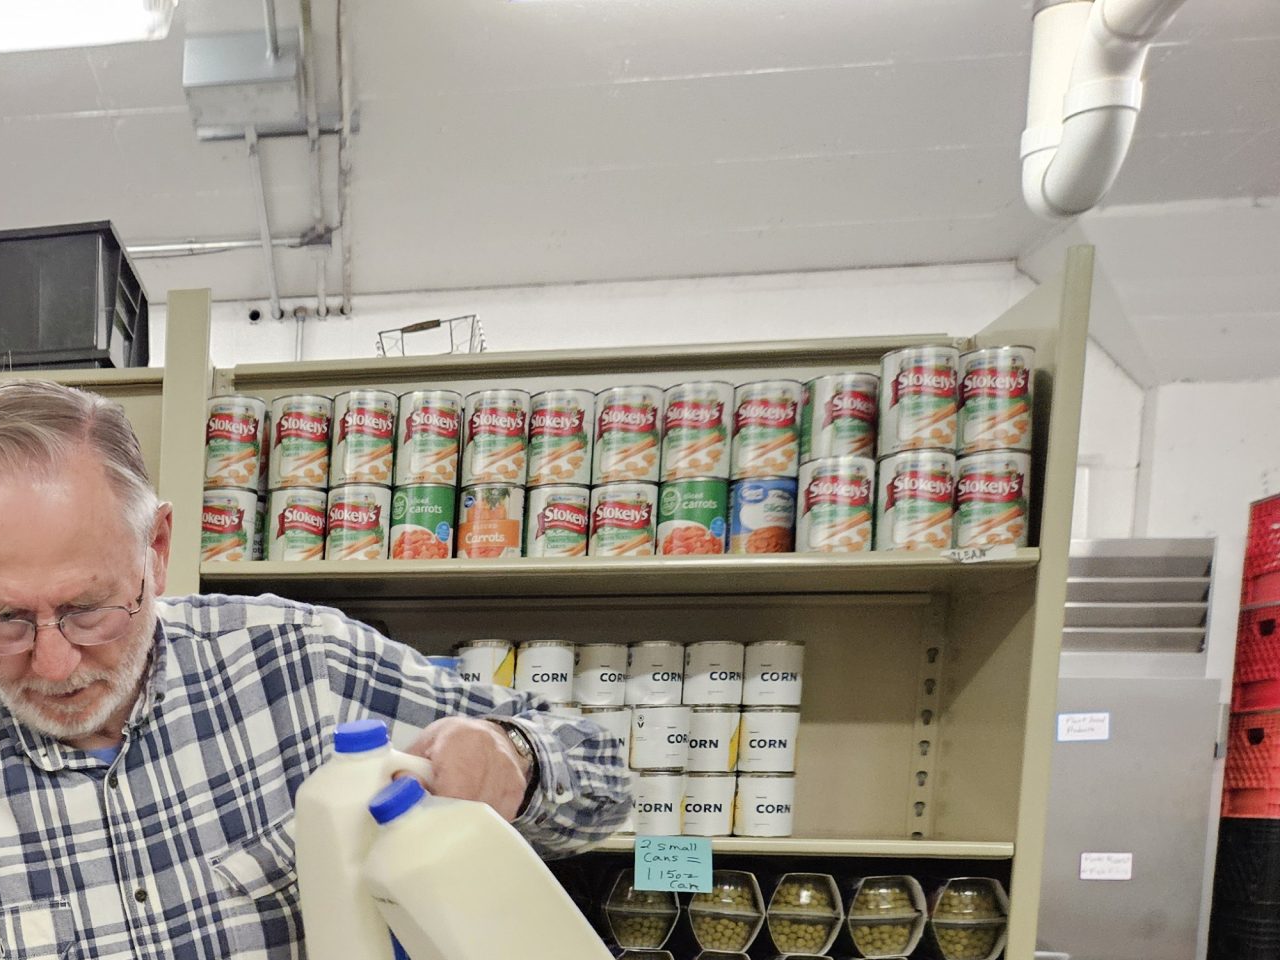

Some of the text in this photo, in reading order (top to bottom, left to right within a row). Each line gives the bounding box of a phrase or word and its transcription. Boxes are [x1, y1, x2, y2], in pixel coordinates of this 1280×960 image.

[898, 373, 956, 390] Stokely's
[963, 373, 1025, 390] Stokely's
[602, 408, 654, 424] Stokely's
[667, 405, 719, 422] Stokely's
[738, 402, 795, 420] Stokely's
[208, 416, 256, 434] Stokely's
[281, 416, 327, 432] Stokely's
[345, 411, 392, 430] Stokely's
[411, 411, 458, 430] Stokely's
[472, 412, 524, 430] Stokely's
[531, 412, 580, 429] Stokely's
[809, 482, 868, 498] Stokely's
[894, 477, 953, 493] Stokely's
[958, 477, 1018, 494] Stokely's
[409, 504, 442, 515] carrots
[682, 499, 718, 510] carrots
[329, 506, 379, 525] Stokely's
[596, 505, 649, 522] Stokely's
[465, 532, 505, 544] Carrots
[532, 673, 568, 683] CORN
[709, 671, 741, 682] CORN
[761, 671, 798, 682] CORN
[749, 738, 788, 749] CORN
[685, 803, 722, 813] CORN
[756, 804, 791, 814] CORN
[640, 839, 697, 852] 2 small
[643, 852, 678, 864] Cans
[670, 880, 700, 891] Can
